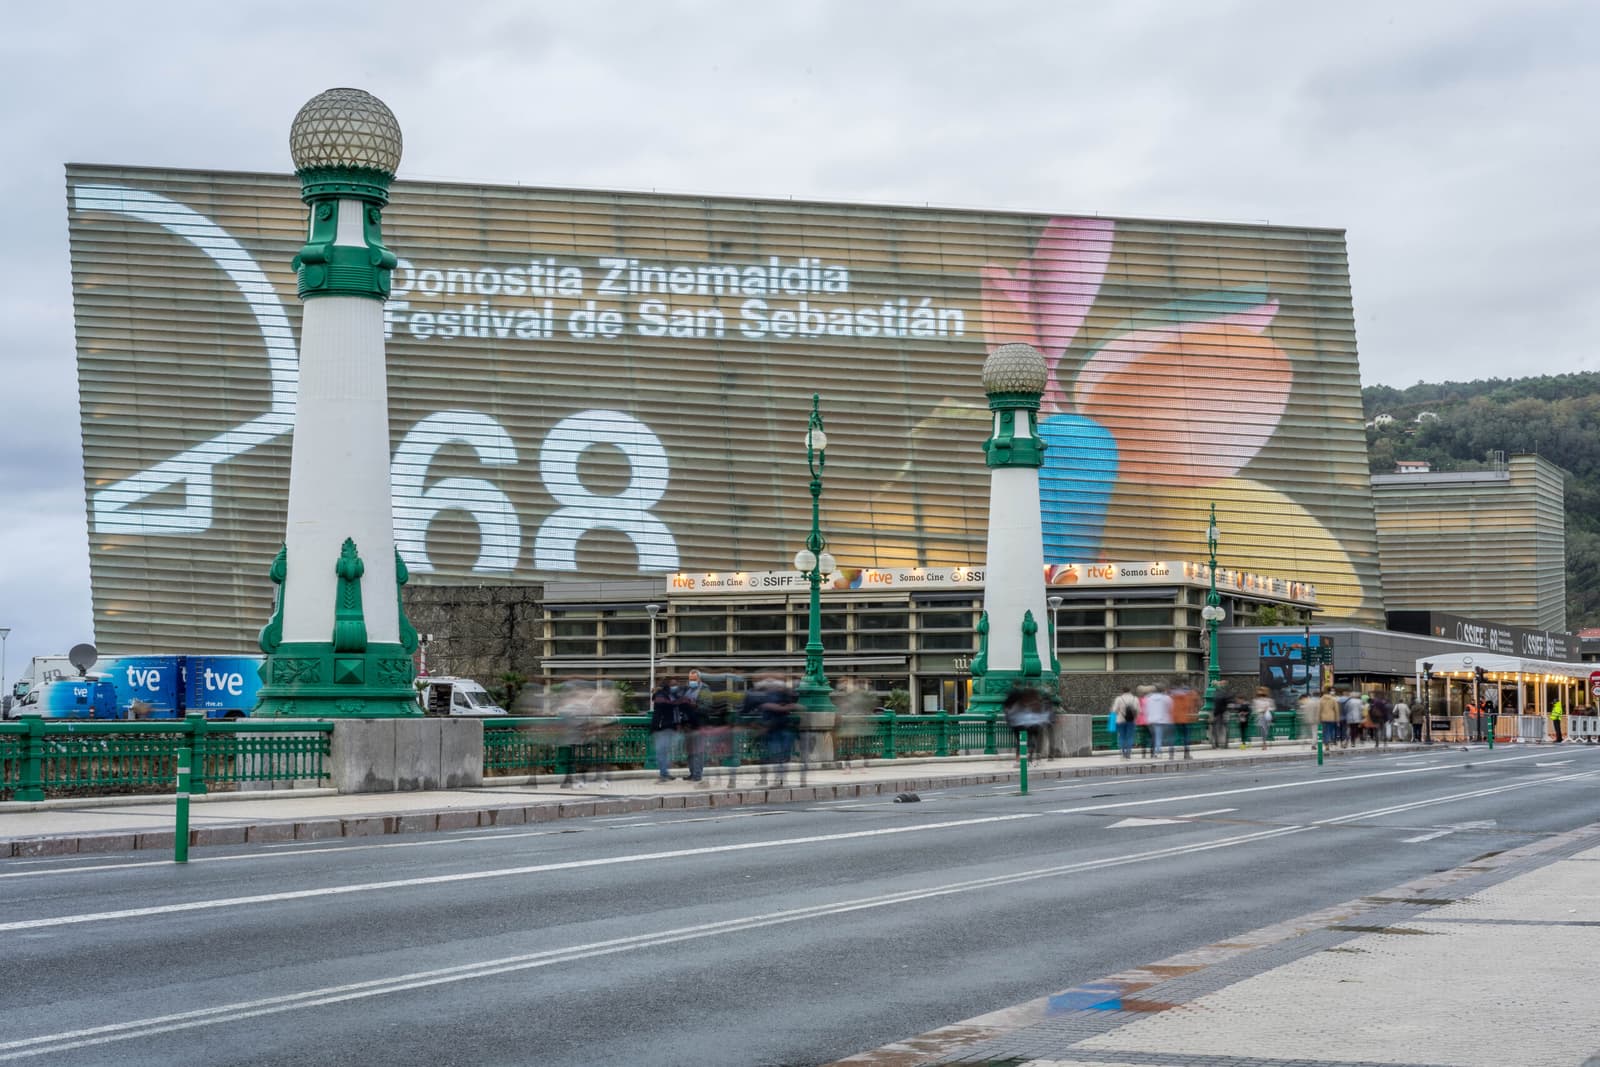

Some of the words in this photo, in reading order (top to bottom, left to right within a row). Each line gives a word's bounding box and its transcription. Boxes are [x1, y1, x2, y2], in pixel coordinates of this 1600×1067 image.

[390, 257, 584, 297] Donostia
[597, 255, 849, 295] Zinemaldia
[384, 299, 554, 340] Festival
[567, 299, 625, 338] de
[636, 298, 725, 338] San
[738, 297, 966, 339] Sebastián
[391, 408, 681, 572] 68
[672, 576, 695, 590] rtve
[701, 578, 725, 587] Somos
[726, 577, 743, 586] Cine
[763, 576, 794, 587] SSIFF
[868, 571, 893, 585] rtve
[899, 573, 925, 582] Somos
[926, 573, 945, 581] Cine
[966, 571, 985, 582] SSI
[1087, 566, 1113, 580] rtve
[1120, 568, 1148, 577] Somos
[1150, 567, 1170, 576] Cine
[126, 665, 161, 692] tve
[203, 667, 244, 696] tve
[73, 687, 88, 698] tve
